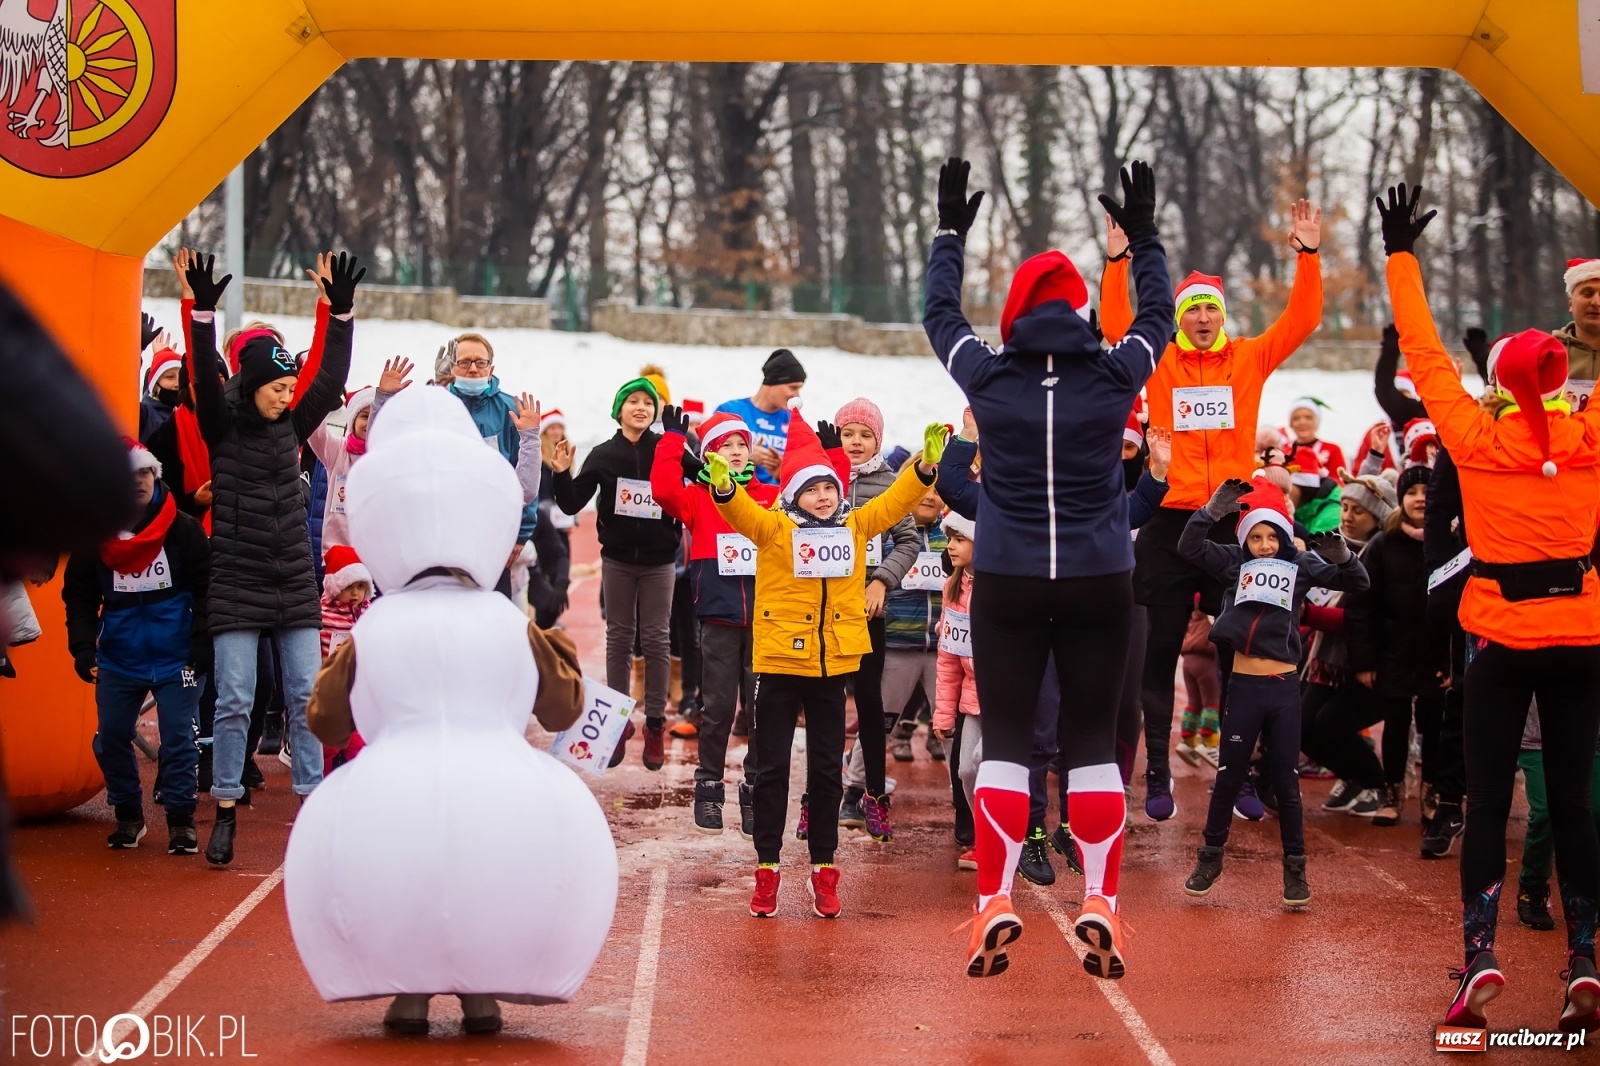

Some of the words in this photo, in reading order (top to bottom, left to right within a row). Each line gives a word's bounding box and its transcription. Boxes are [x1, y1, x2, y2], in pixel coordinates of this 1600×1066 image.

[1194, 402, 1228, 417] 052
[818, 545, 851, 562] 008
[1254, 572, 1290, 593] 002
[581, 698, 612, 741] 021
